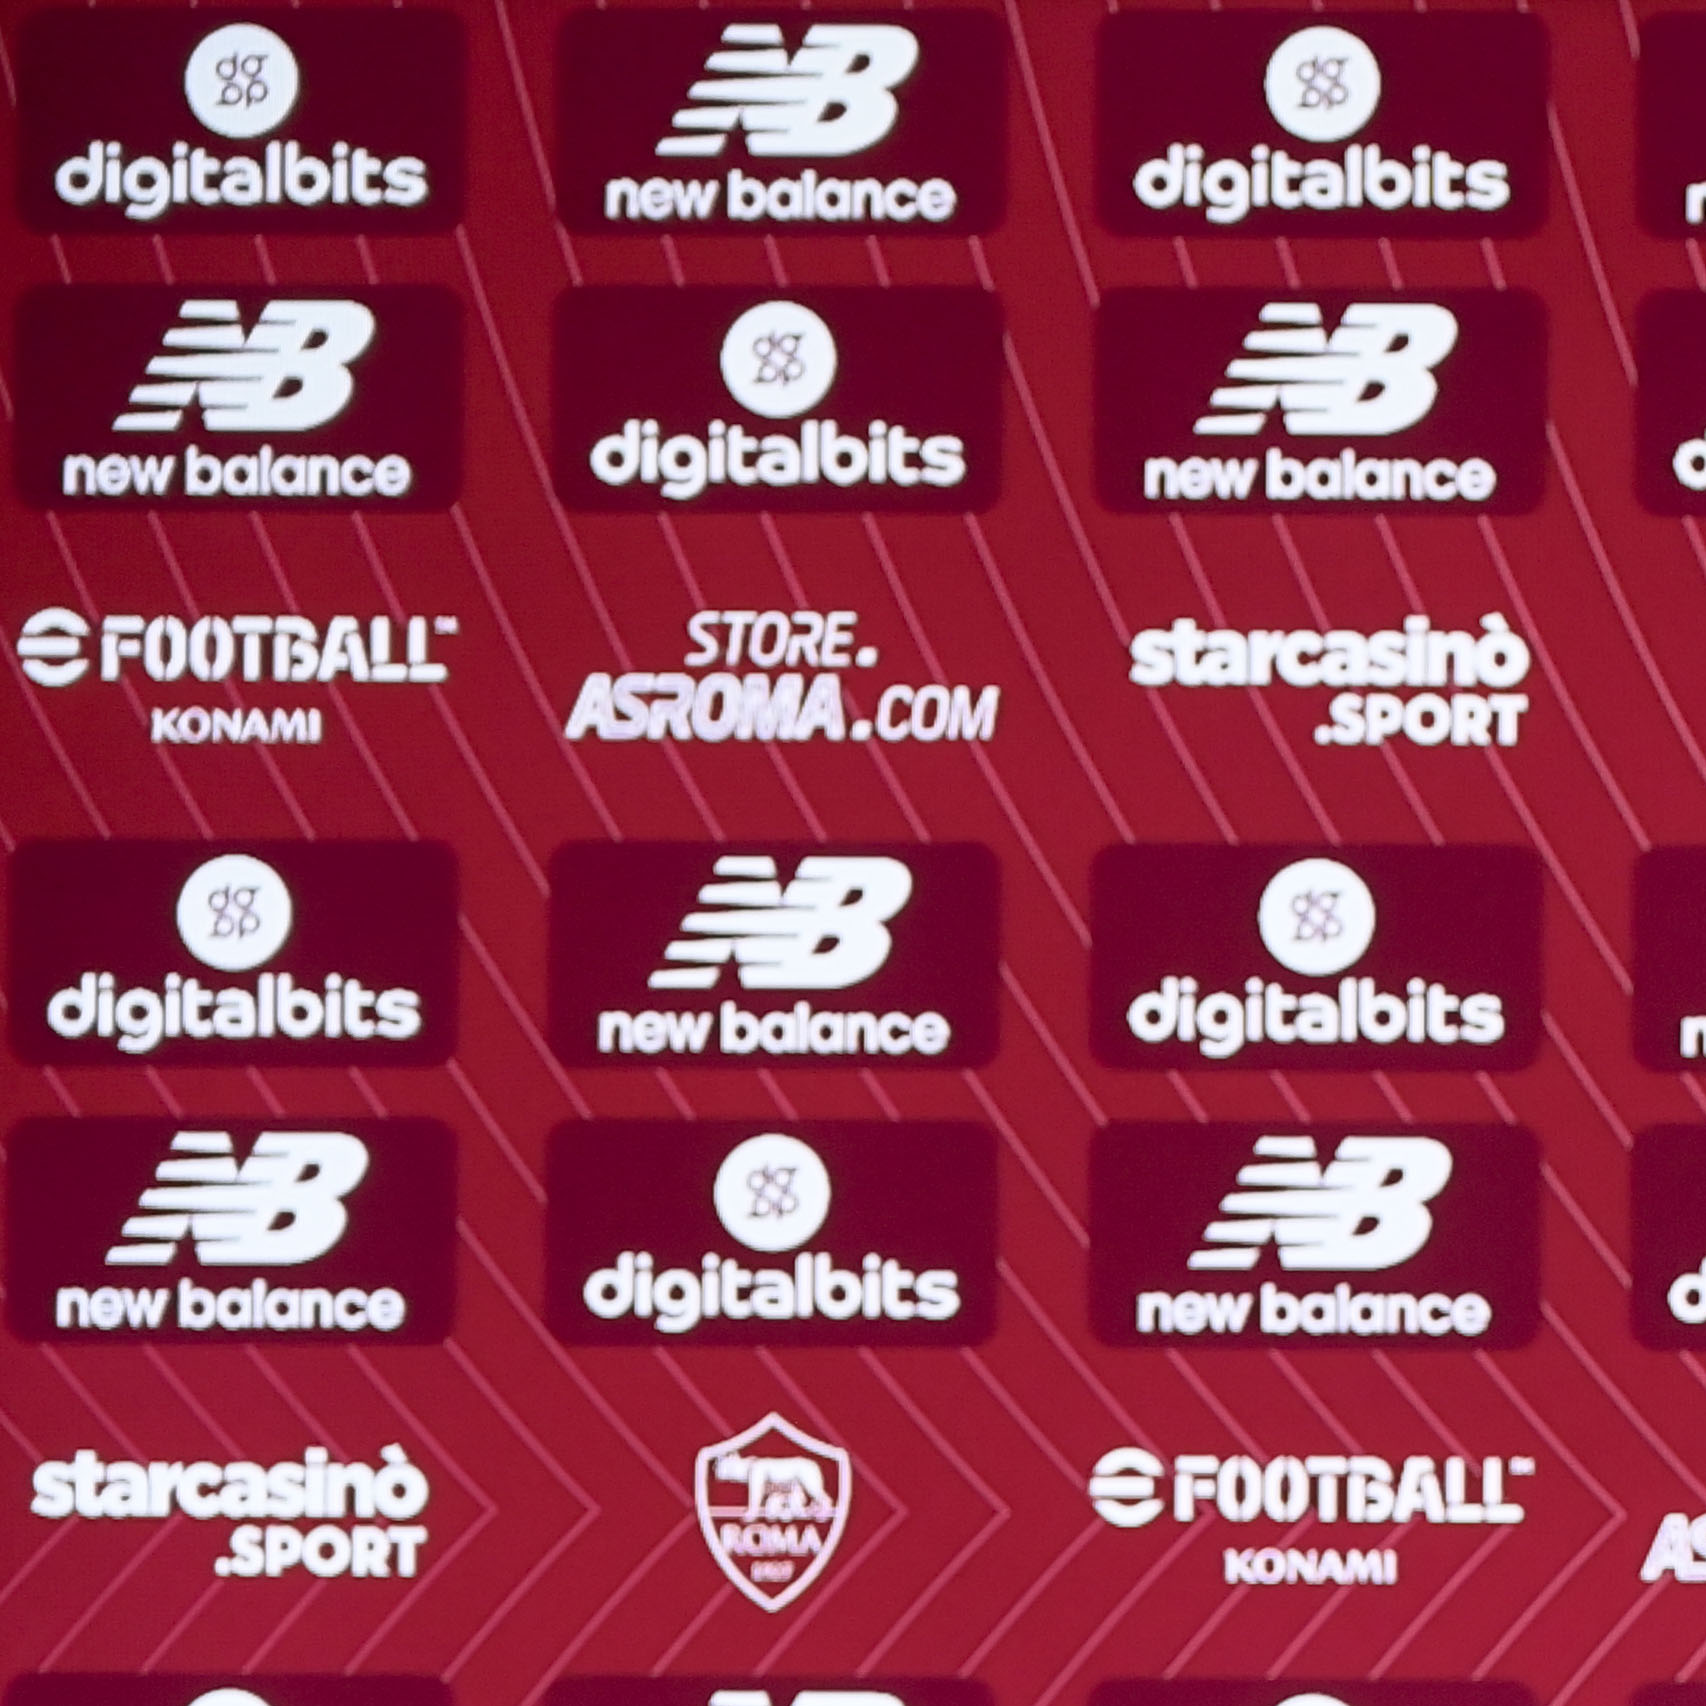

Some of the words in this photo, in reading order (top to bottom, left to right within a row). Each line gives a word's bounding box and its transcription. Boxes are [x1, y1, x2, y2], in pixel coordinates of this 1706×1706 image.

[56, 144, 427, 219] digitalbits
[606, 178, 719, 220] new
[728, 169, 956, 221] balance
[1133, 147, 1509, 223] digitalbits
[64, 454, 175, 495] new
[186, 445, 411, 496] balance
[591, 421, 965, 499] digitalbits
[1145, 457, 1258, 499] new
[1266, 448, 1496, 500] balance
[1130, 612, 1530, 687] starcasinò
[152, 707, 321, 743] KONAMI
[565, 674, 999, 742] ASROMA.COM
[48, 975, 420, 1053] digitalbits
[599, 1011, 713, 1053] new
[720, 1001, 950, 1054] balance
[1127, 979, 1504, 1058] digitalbits
[57, 1287, 169, 1329] new
[178, 1278, 405, 1331] balance
[584, 1254, 960, 1333] digitalbits
[1138, 1292, 1253, 1334] new
[1260, 1283, 1491, 1336] balance
[31, 1443, 429, 1519] starcasinò
[1225, 1548, 1397, 1584] KONAMI
